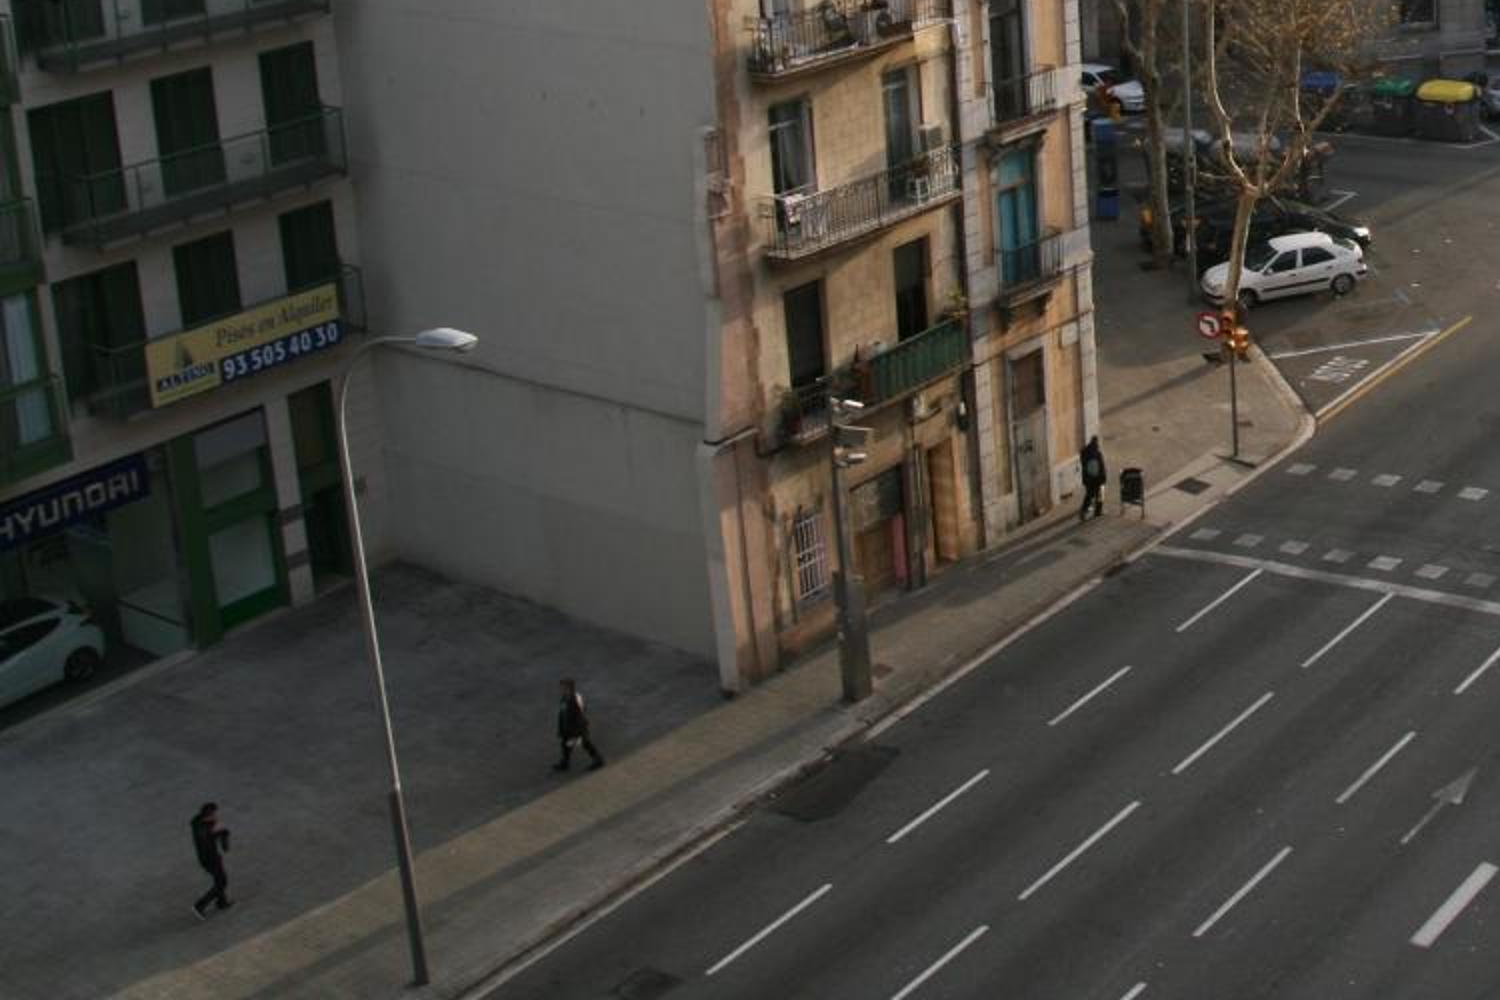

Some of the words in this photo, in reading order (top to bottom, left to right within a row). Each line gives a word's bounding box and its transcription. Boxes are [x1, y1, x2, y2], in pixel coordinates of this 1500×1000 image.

[223, 354, 248, 380] 93
[251, 342, 286, 370] 505
[315, 322, 338, 346] 30
[0, 469, 139, 540] HYUNDAI
